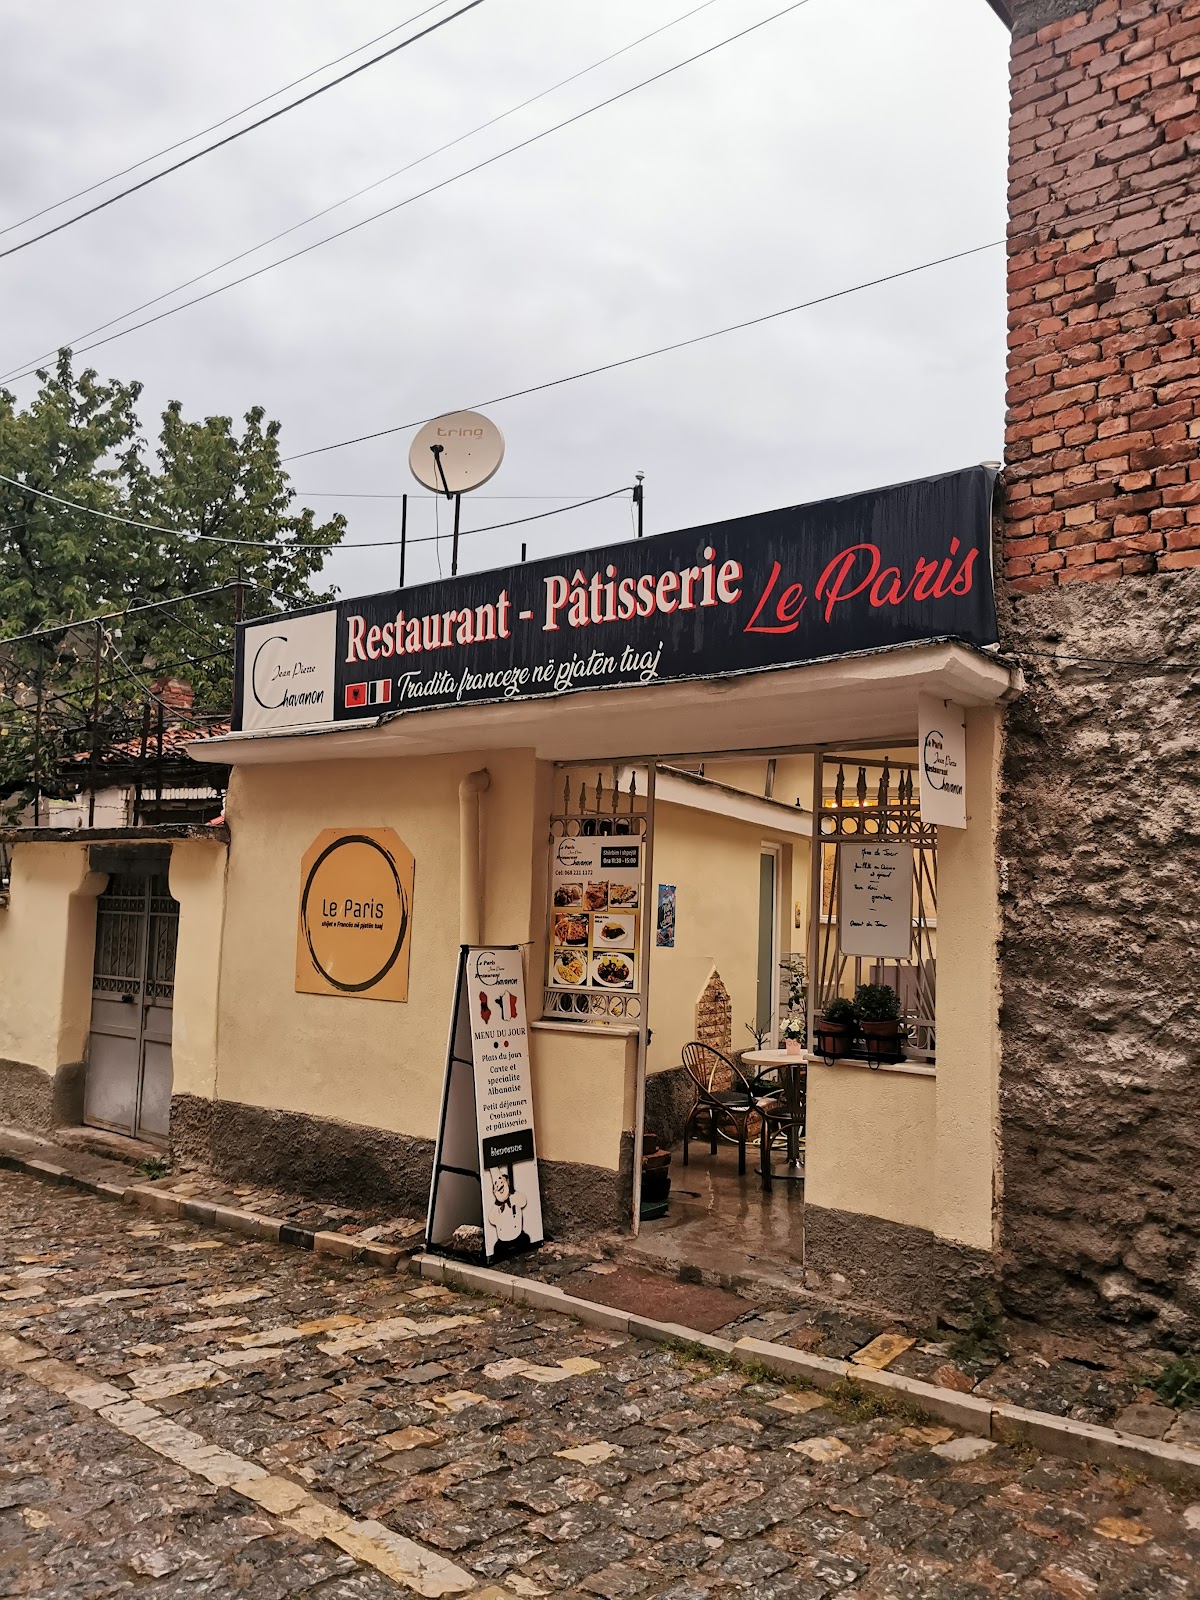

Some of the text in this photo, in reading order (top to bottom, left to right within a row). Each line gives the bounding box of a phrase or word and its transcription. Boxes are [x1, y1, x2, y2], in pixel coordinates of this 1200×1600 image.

[437, 428, 483, 439] tring
[743, 536, 979, 635] Le Paris
[345, 590, 511, 663] Restaurant
[541, 546, 743, 632] Pâtisserie
[252, 636, 324, 709] Chavanon
[271, 665, 291, 681] Jean
[397, 641, 664, 702] Tradita franceze në pjatën tuaj
[925, 763, 948, 776] Restaurant
[323, 898, 384, 919] Le Paris
[474, 1027, 526, 1040] MENU DU JOUR
[481, 1051, 522, 1062] Plats du jour
[489, 1063, 516, 1074] Carte et
[487, 1084, 522, 1096] Albanaise
[482, 1098, 527, 1112] Petit déjeuner
[489, 1109, 522, 1121] Croissants
[485, 1118, 527, 1132] et pâtisseries
